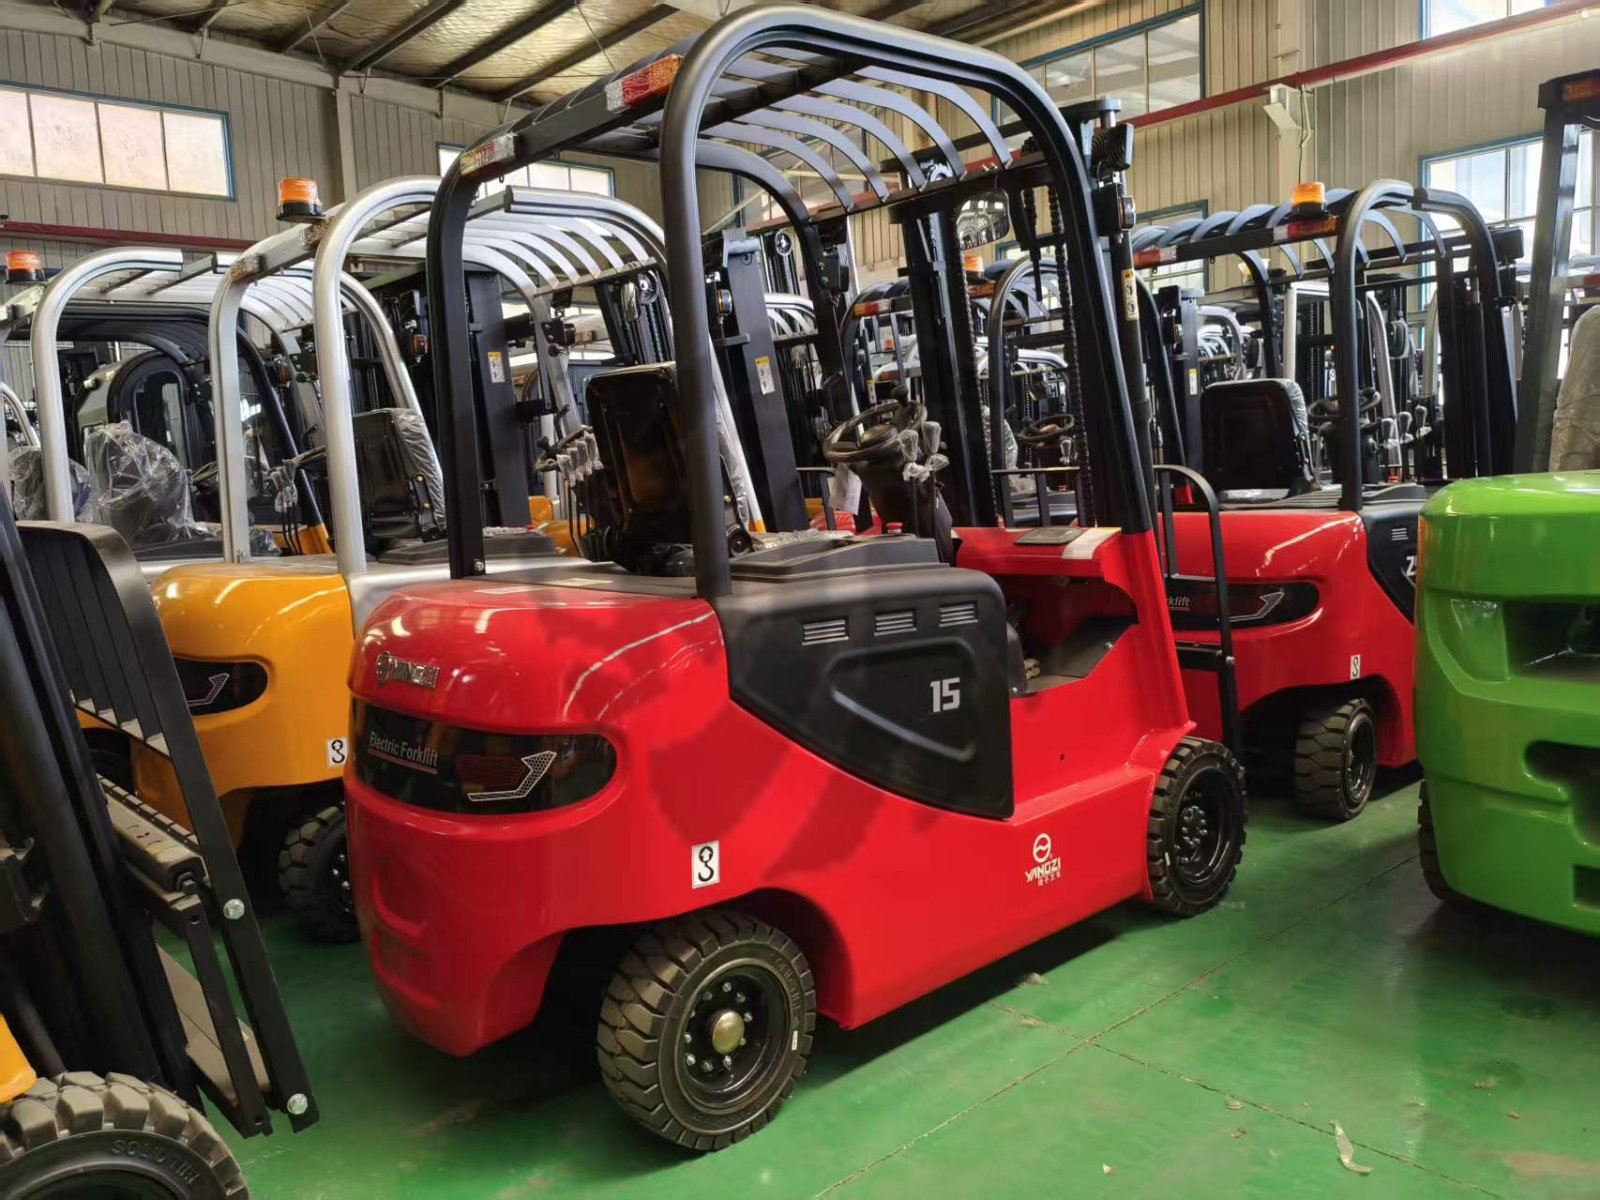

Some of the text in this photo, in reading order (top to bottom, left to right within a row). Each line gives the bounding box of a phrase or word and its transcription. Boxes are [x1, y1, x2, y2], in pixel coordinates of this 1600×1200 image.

[929, 677, 961, 713] 15
[369, 731, 439, 768] Electric Forklift
[1024, 856, 1062, 883] YANGZI
